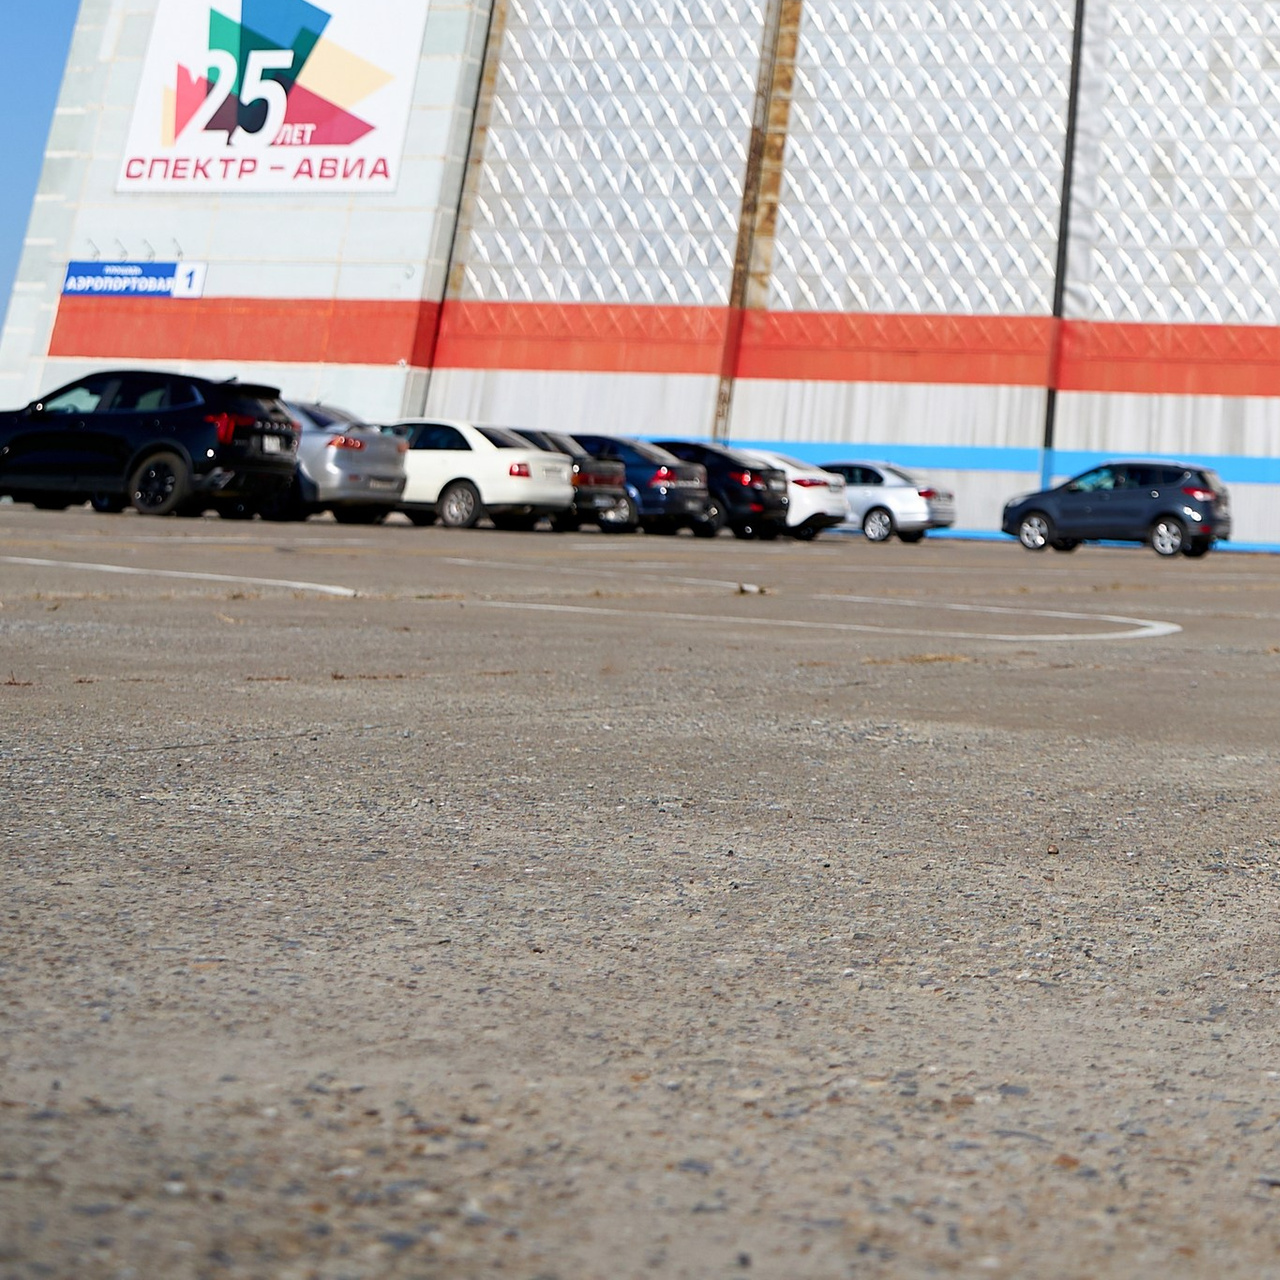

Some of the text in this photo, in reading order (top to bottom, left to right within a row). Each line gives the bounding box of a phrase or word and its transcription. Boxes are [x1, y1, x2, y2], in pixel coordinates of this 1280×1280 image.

[175, 49, 316, 146] 25 ЛЕТ
[186, 270, 195, 289] 1
